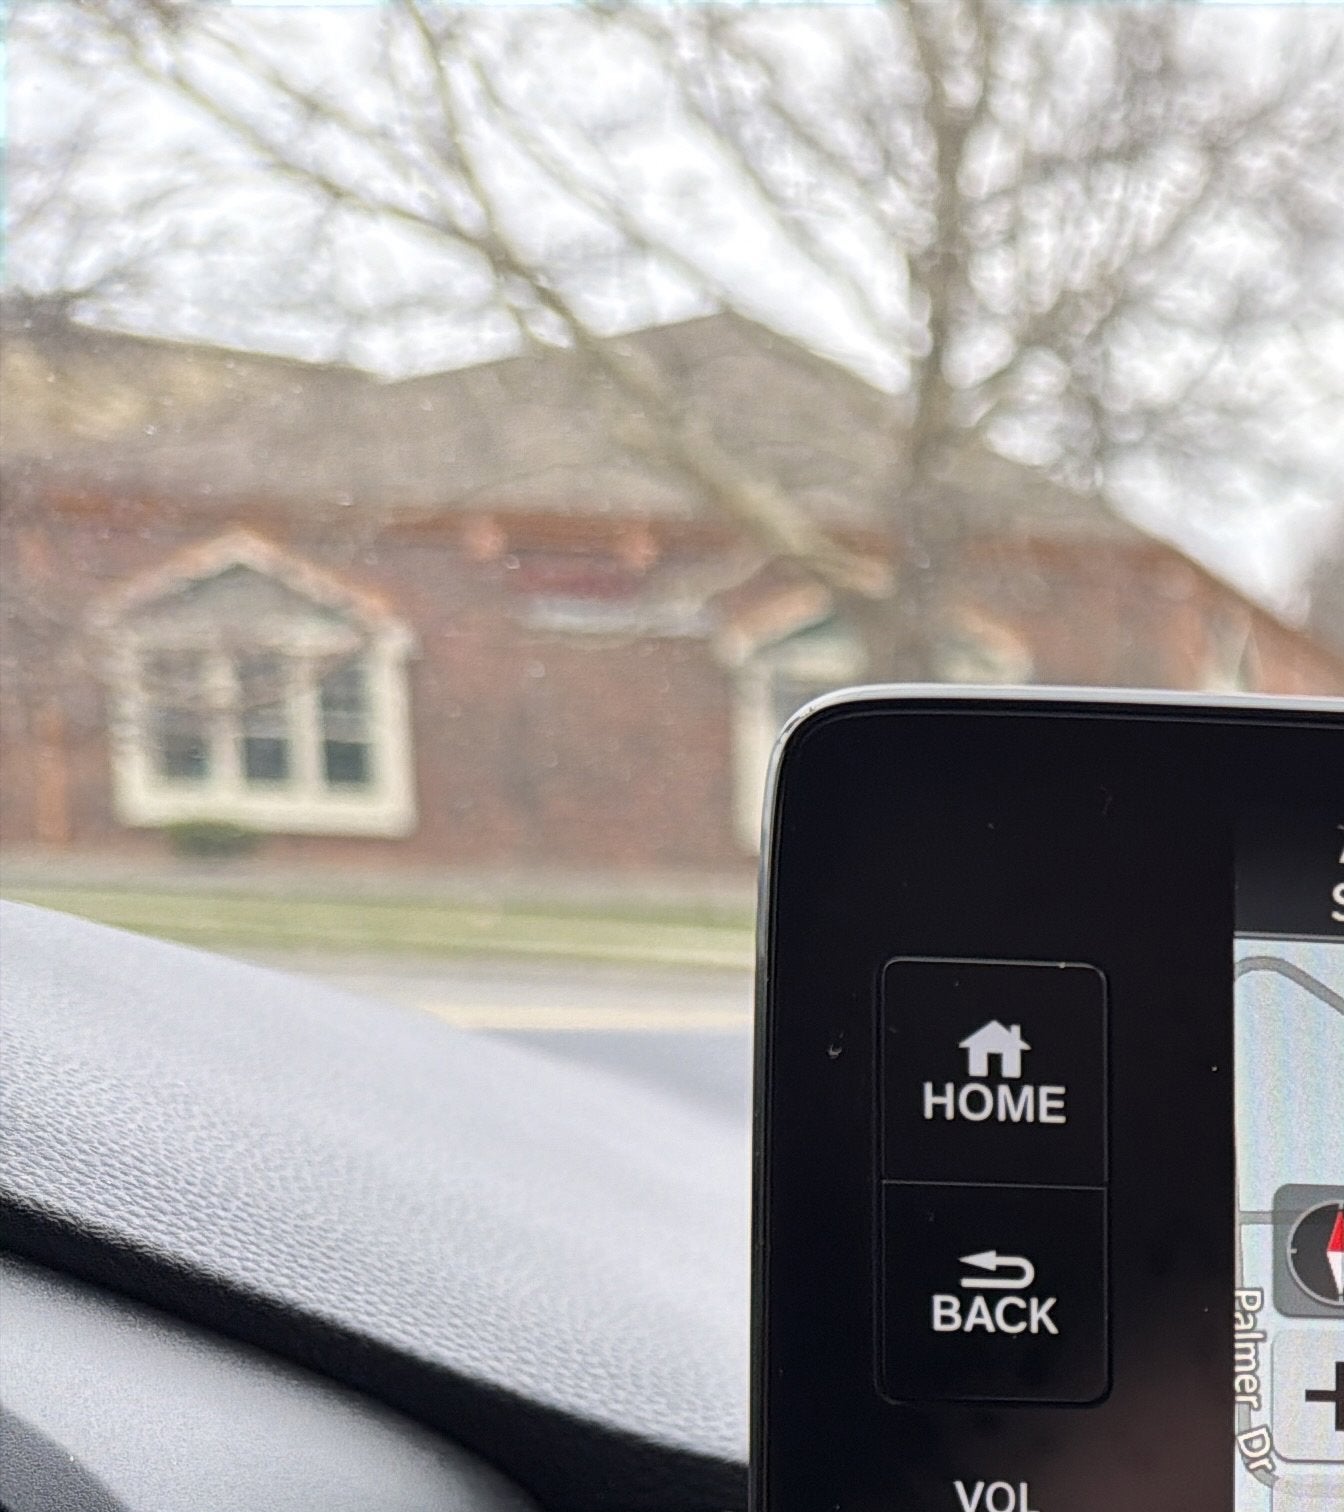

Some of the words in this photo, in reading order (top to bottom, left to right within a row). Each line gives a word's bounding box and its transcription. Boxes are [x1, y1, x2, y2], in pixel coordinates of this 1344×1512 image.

[922, 1080, 1067, 1125] HOME
[931, 1294, 1059, 1336] BACK
[1233, 1289, 1265, 1410] Palmer
[1237, 1426, 1275, 1474] Dr
